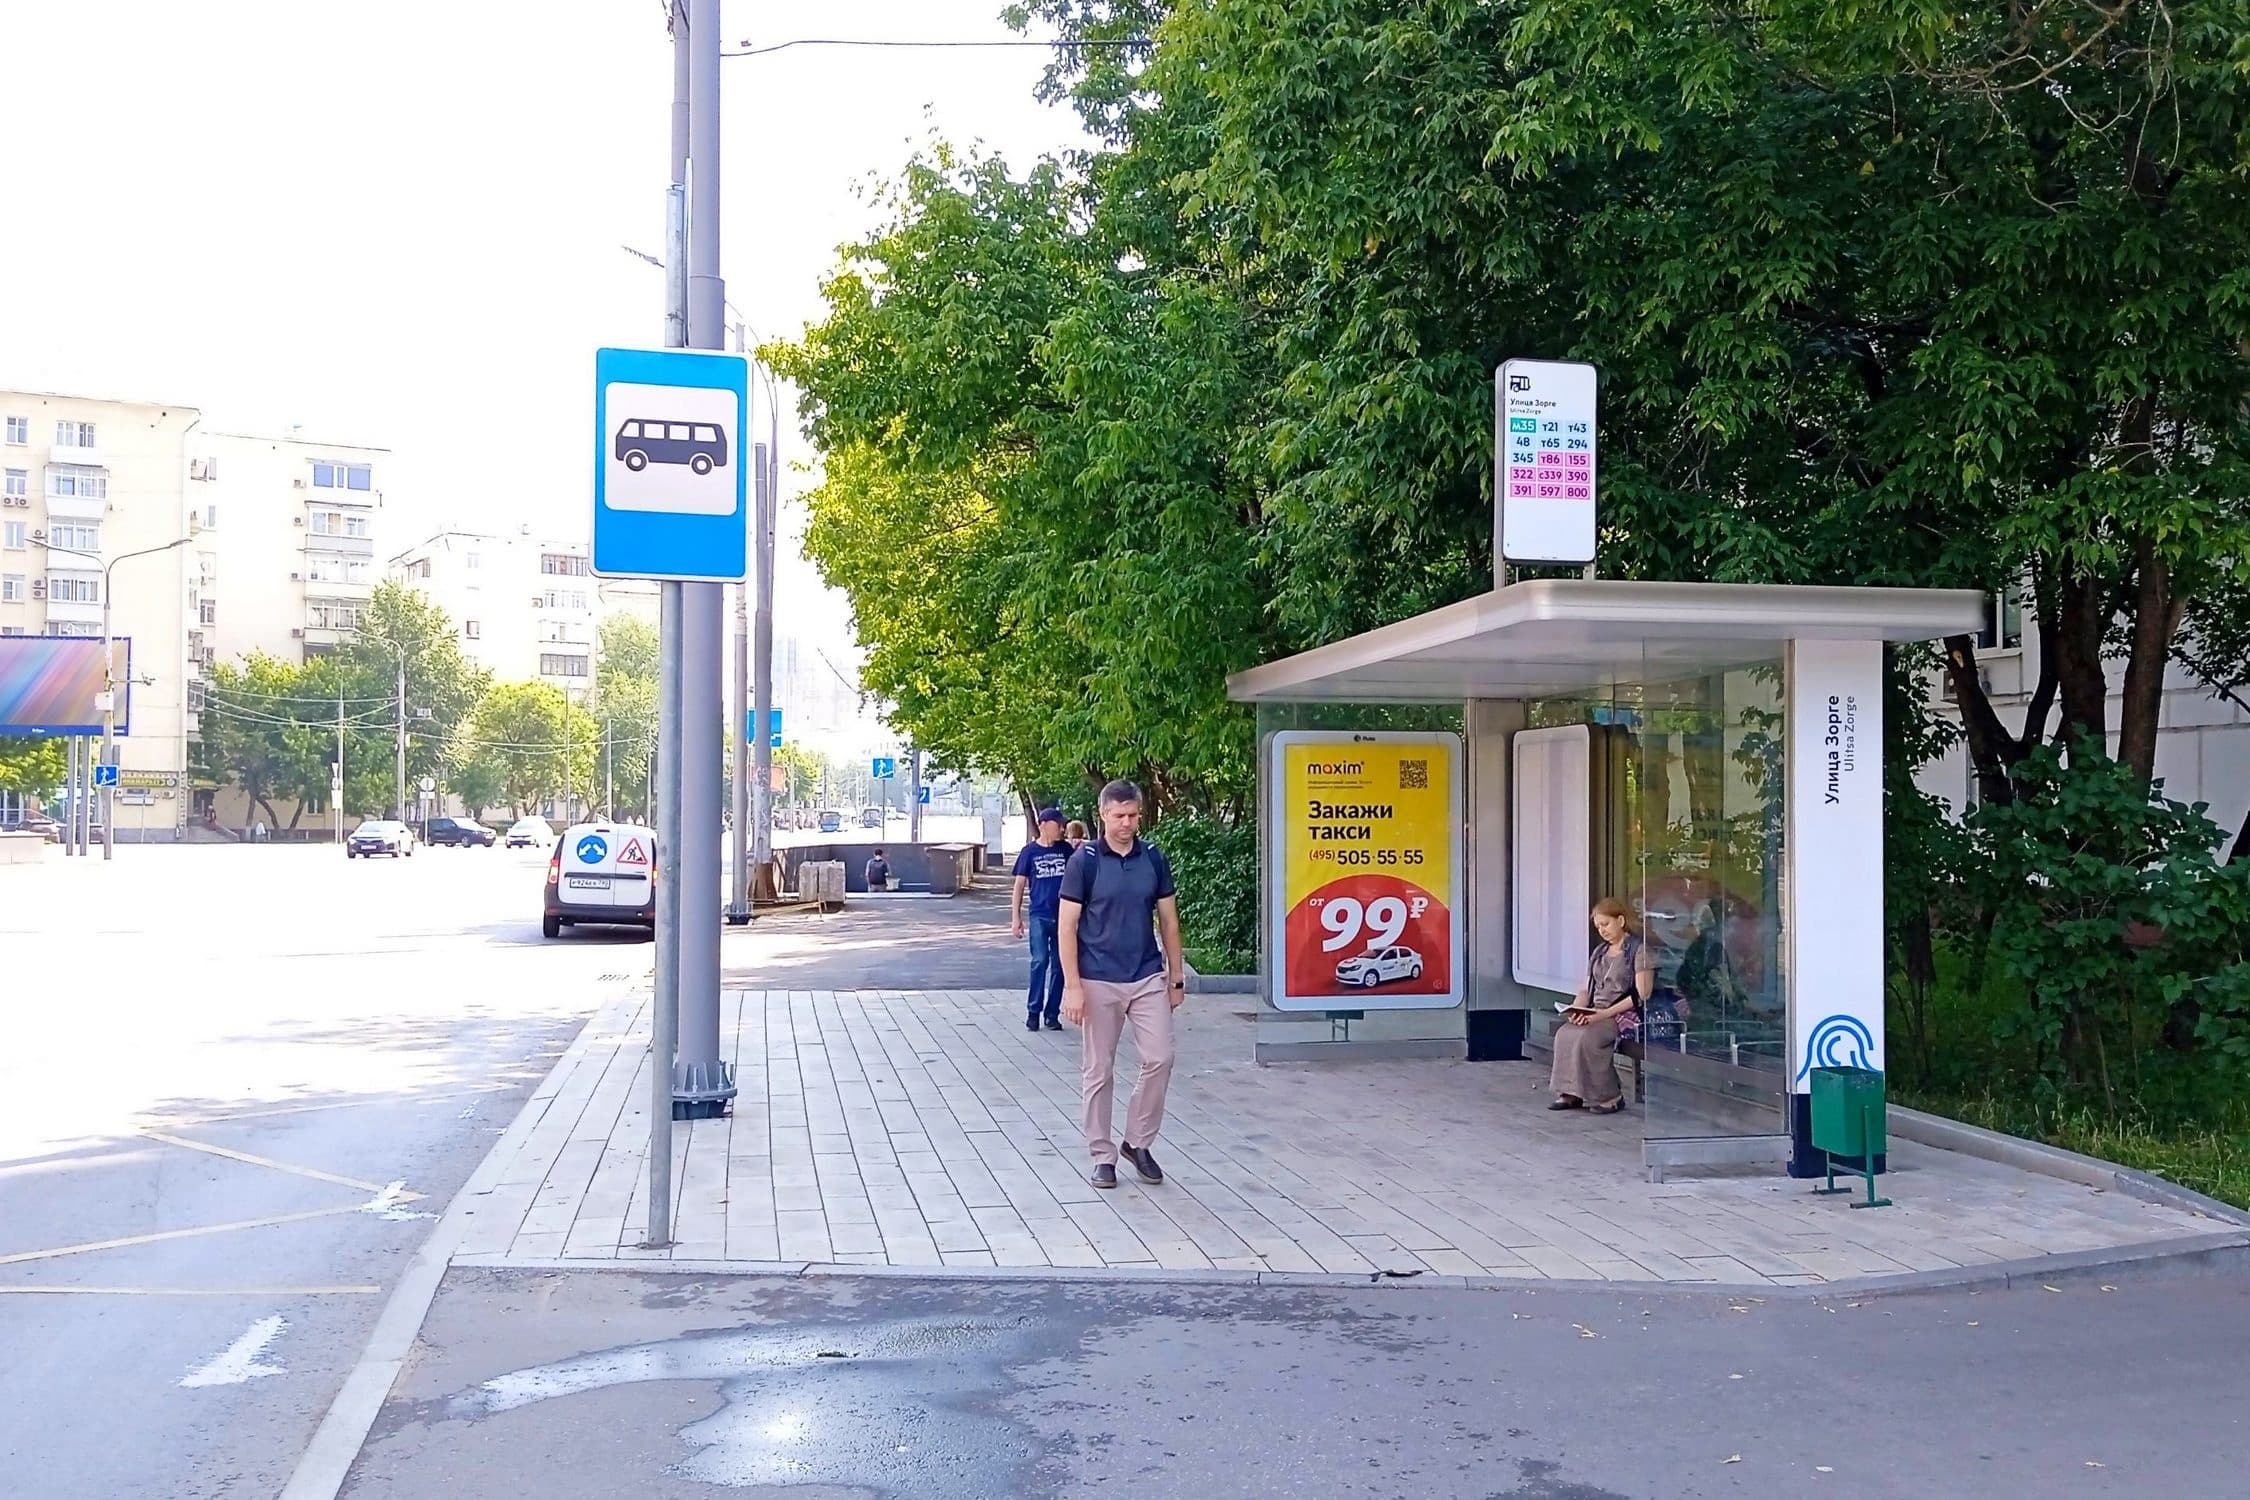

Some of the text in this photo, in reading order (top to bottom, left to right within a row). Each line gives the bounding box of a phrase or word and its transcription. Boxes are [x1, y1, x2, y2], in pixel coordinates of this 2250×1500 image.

[1510, 398, 1556, 408] Улица Зорге
[1511, 421, 1587, 433] м35 т21 т43
[1516, 437, 1587, 449] 48 т65 294
[1513, 453, 1587, 465] 345 т86 155
[1513, 469, 1533, 479] 322
[1567, 471, 1587, 482] 390
[1514, 485, 1588, 498] 391 597 800
[1844, 696, 1857, 772] Ulitsa Zorge
[1825, 696, 1842, 804] Улица Зорге
[1308, 801, 1393, 819] Закажи
[1308, 826, 1371, 840] такси
[1309, 849, 1335, 861] (495)
[1309, 897, 1324, 907] от
[1320, 897, 1408, 952] 99
